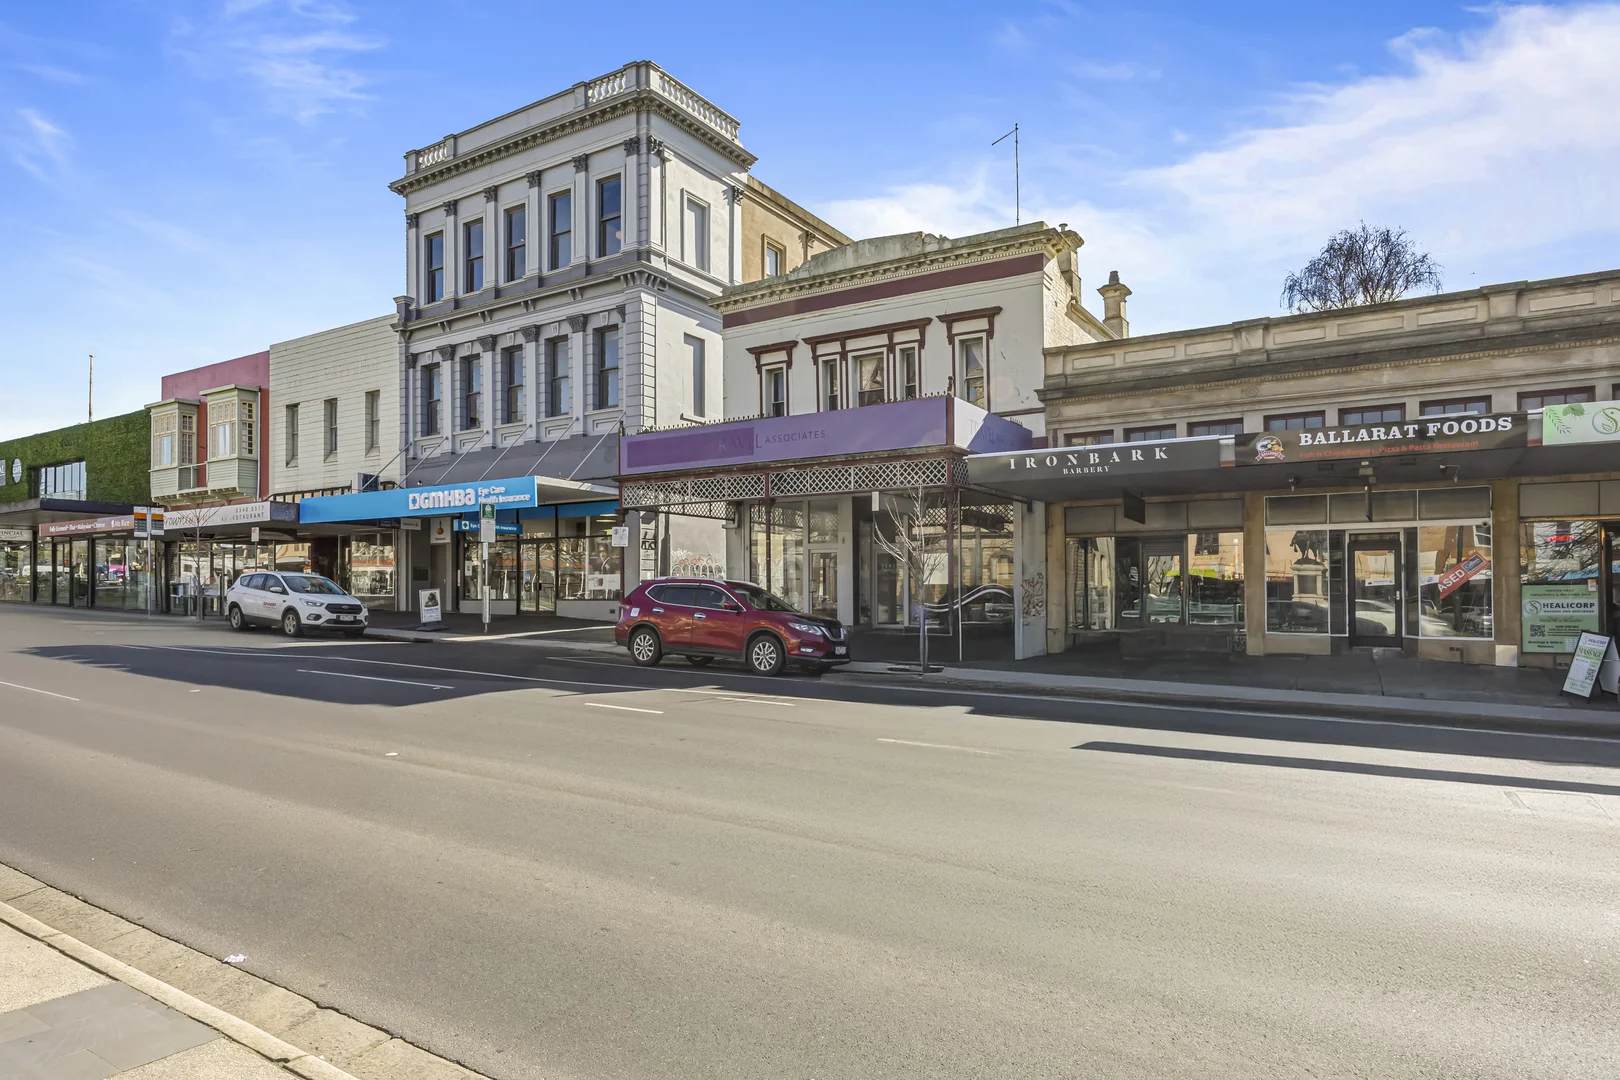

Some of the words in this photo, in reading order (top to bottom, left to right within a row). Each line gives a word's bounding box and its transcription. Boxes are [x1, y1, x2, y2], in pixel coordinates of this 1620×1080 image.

[764, 429, 826, 444] ASSOCIATES
[1299, 424, 1419, 446] BALLARAT
[1426, 416, 1513, 437] FOODS
[1379, 445, 1400, 453] Pizza
[1433, 440, 1479, 449] Restaurant
[1009, 447, 1168, 470] IRONBARK
[13, 464, 22, 475] CAFE
[1063, 465, 1110, 475] BARBERY
[478, 487, 490, 495] Eye
[490, 486, 506, 494] Care
[500, 493, 531, 504] Insurance
[1437, 569, 1466, 592] ASED
